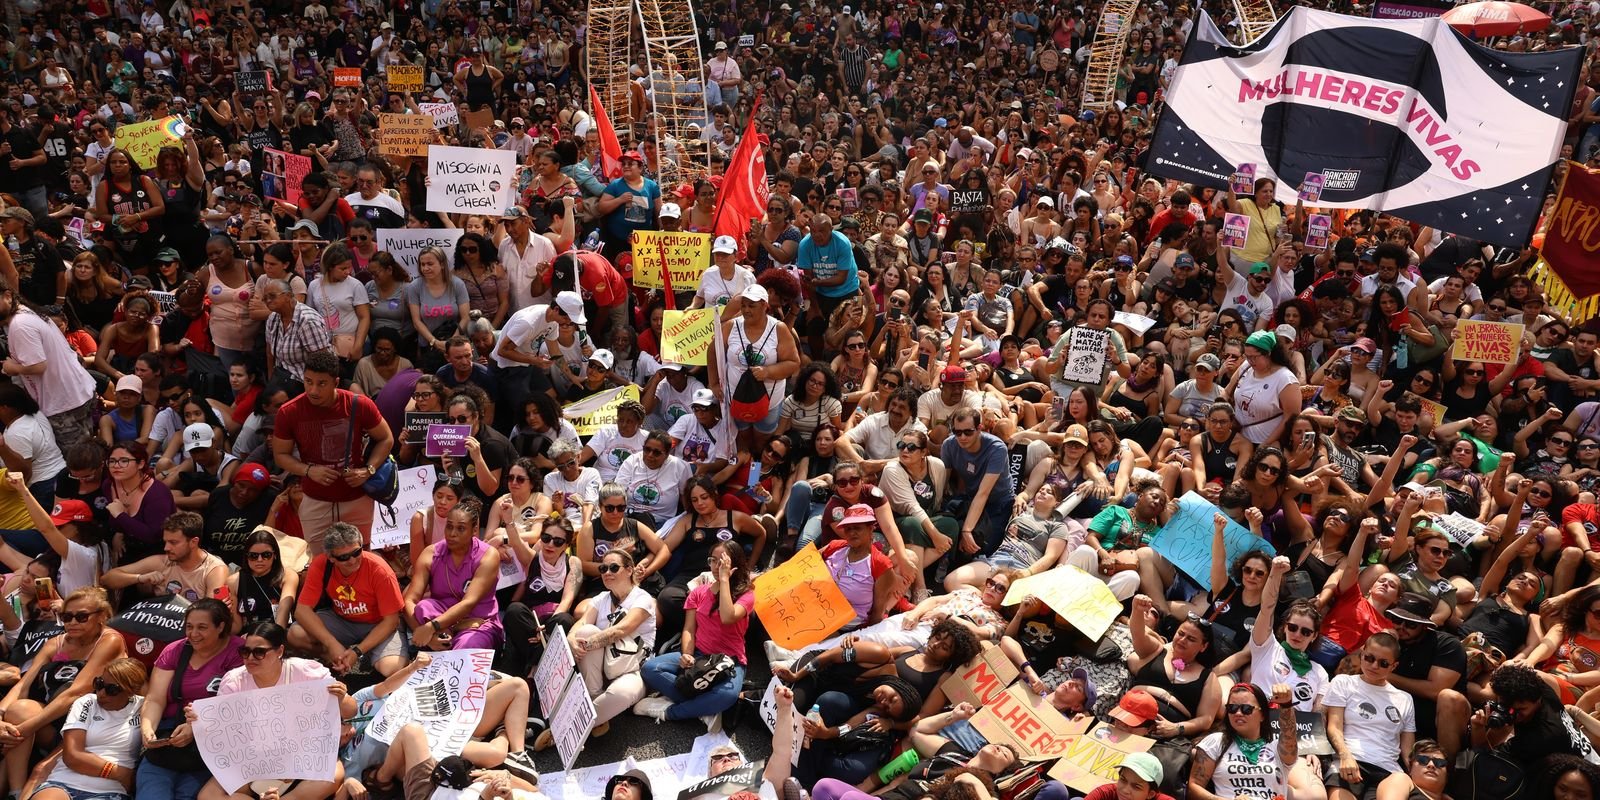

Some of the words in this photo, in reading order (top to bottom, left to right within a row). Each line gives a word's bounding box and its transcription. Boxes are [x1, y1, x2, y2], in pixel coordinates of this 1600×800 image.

[1379, 6, 1411, 18] CASSAÇÃO
[1412, 9, 1423, 18] DO
[1425, 11, 1443, 19] LUC
[391, 66, 422, 75] MACHISMO
[388, 83, 423, 91] CAPITALISMO
[413, 118, 424, 126] SE
[433, 114, 458, 127] VIVAS
[1238, 70, 1405, 115] MULHERES
[1406, 97, 1481, 181] VIVAS
[44, 138, 67, 157] 46
[124, 141, 150, 152] TEM
[445, 179, 486, 196] MATA!
[1324, 180, 1355, 189] EMINISTA
[454, 194, 497, 210] CHEGA!
[953, 191, 984, 205] BASTA
[385, 237, 452, 252] MULHERES
[632, 232, 640, 244] O
[645, 234, 702, 248] MACHISMO
[643, 256, 691, 268] FASISMO
[663, 311, 706, 342] MULHERES
[1464, 324, 1477, 333] UM
[1076, 330, 1095, 339] PARE
[1094, 333, 1105, 341] DE
[1465, 332, 1475, 340] DE
[687, 340, 709, 359] LUTA
[1075, 339, 1103, 349] MATAR
[1465, 340, 1512, 354] VIVAS
[1465, 351, 1471, 359] E
[1473, 352, 1511, 362] LIVRES
[432, 433, 464, 441] QUEREMOS
[403, 484, 416, 492] UM
[224, 518, 248, 529] THE
[765, 584, 796, 627] MATAR
[121, 613, 132, 621] a
[133, 610, 185, 632] menos!
[433, 679, 453, 717] MISOGINIA
[201, 694, 286, 733] SOMOS
[962, 662, 1074, 756] MULHERES
[204, 717, 287, 754] GRITO
[295, 711, 332, 733] DAS
[1270, 720, 1313, 732] QUMOS
[214, 745, 258, 770] QUE
[240, 757, 286, 780] MAIS
[293, 755, 329, 774] AQUI
[1227, 764, 1274, 775] como
[688, 782, 698, 793] a
[699, 768, 755, 789] menos!
[1229, 777, 1266, 788] uma
